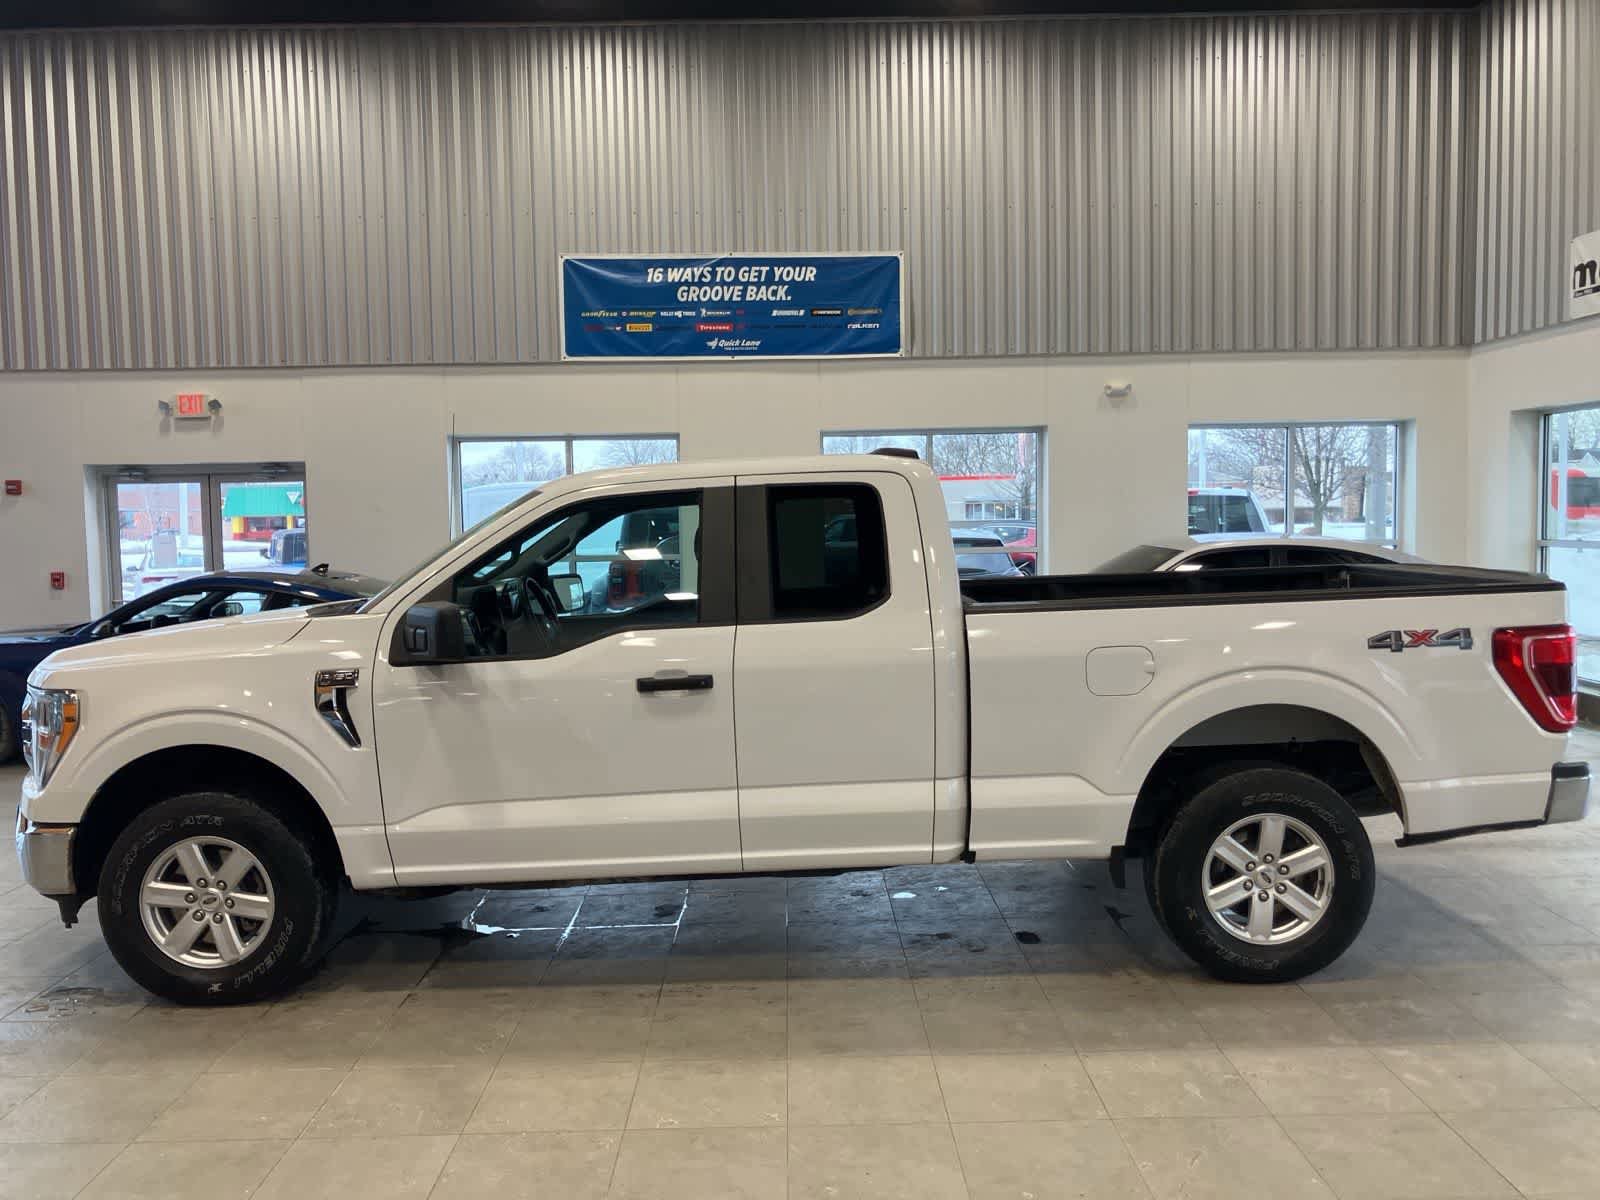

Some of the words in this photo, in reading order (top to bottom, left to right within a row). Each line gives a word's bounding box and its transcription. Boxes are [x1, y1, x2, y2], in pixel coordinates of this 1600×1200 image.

[647, 267, 664, 283] 16
[667, 267, 712, 283] WAYS
[715, 266, 736, 282] TO
[738, 266, 769, 282] GET
[774, 266, 817, 282] YOUR
[677, 285, 743, 302] GROOVE
[745, 285, 792, 301] BACK.
[718, 338, 741, 347] Quick
[741, 338, 761, 346] Lane
[178, 394, 204, 414] EXIT
